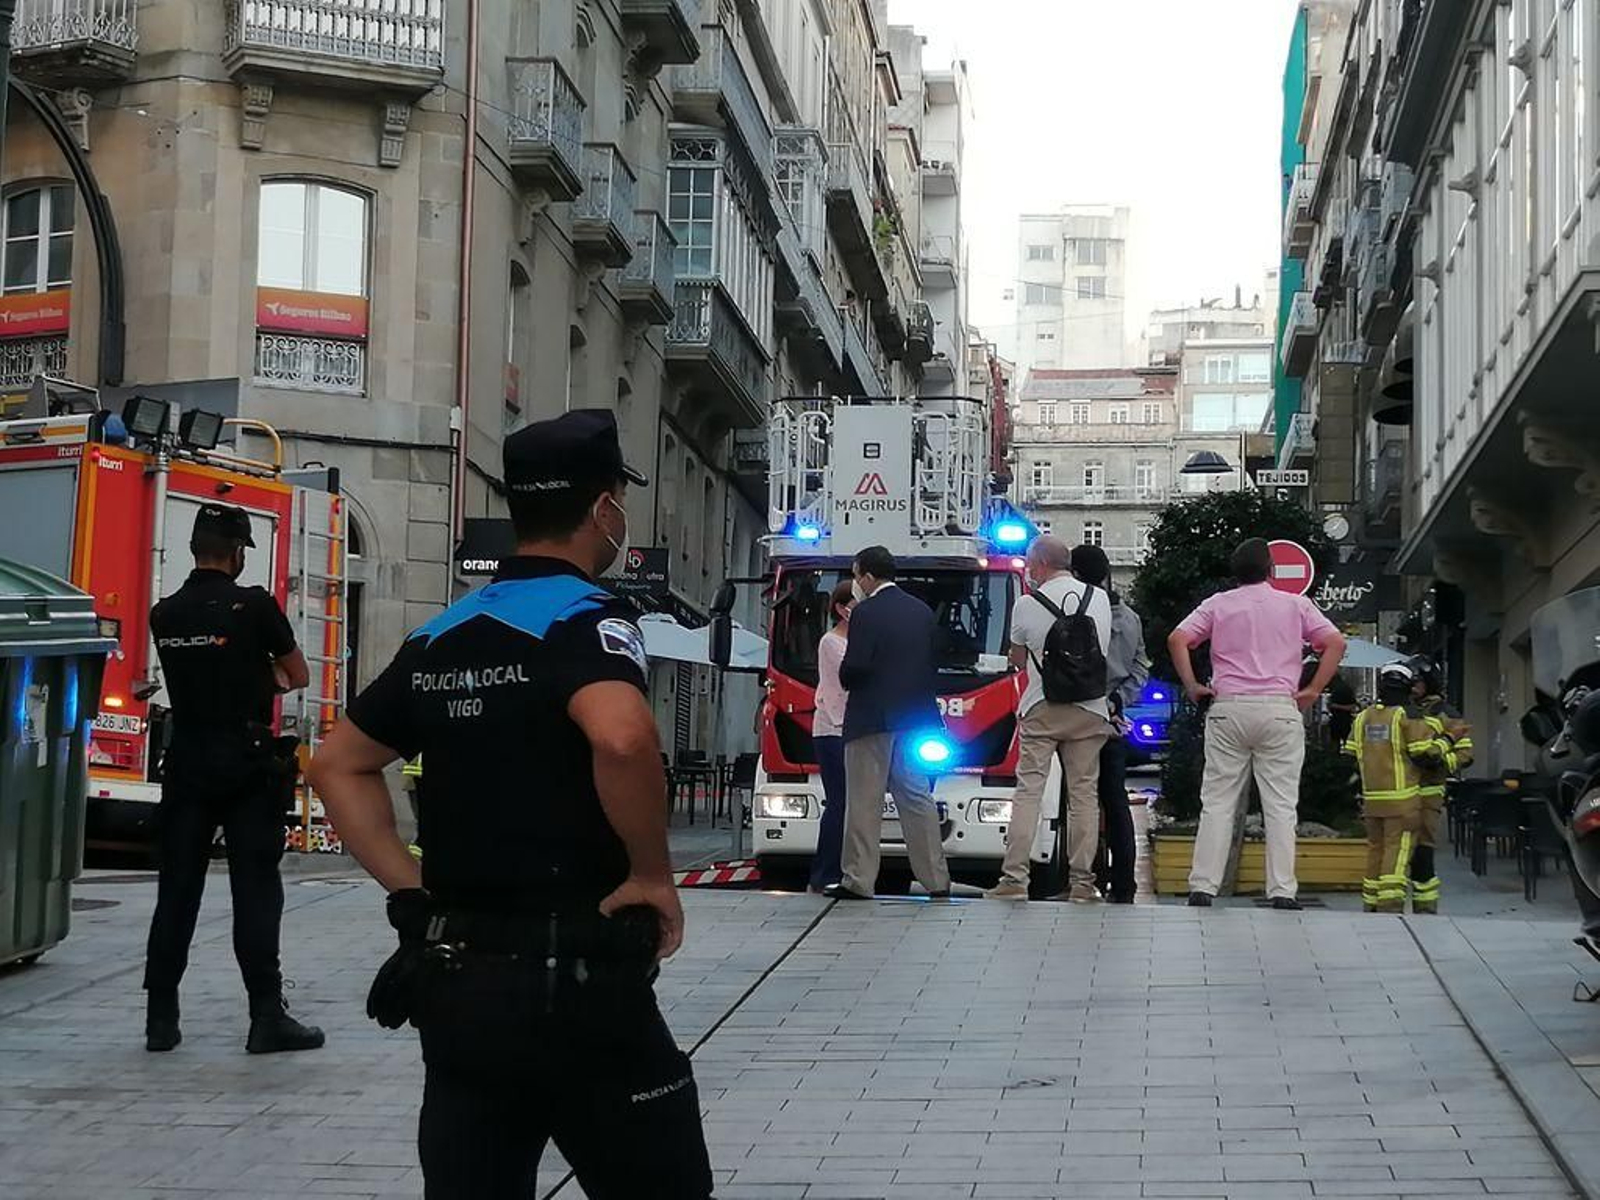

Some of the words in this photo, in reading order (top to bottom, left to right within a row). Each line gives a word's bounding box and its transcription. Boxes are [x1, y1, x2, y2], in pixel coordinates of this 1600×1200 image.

[835, 499, 907, 511] MAGIRUS
[411, 668, 466, 692] POLICÍA
[474, 664, 530, 688] LOCAL
[447, 698, 483, 719] VIGO
[95, 713, 114, 729] 826
[119, 716, 139, 731] JNZ
